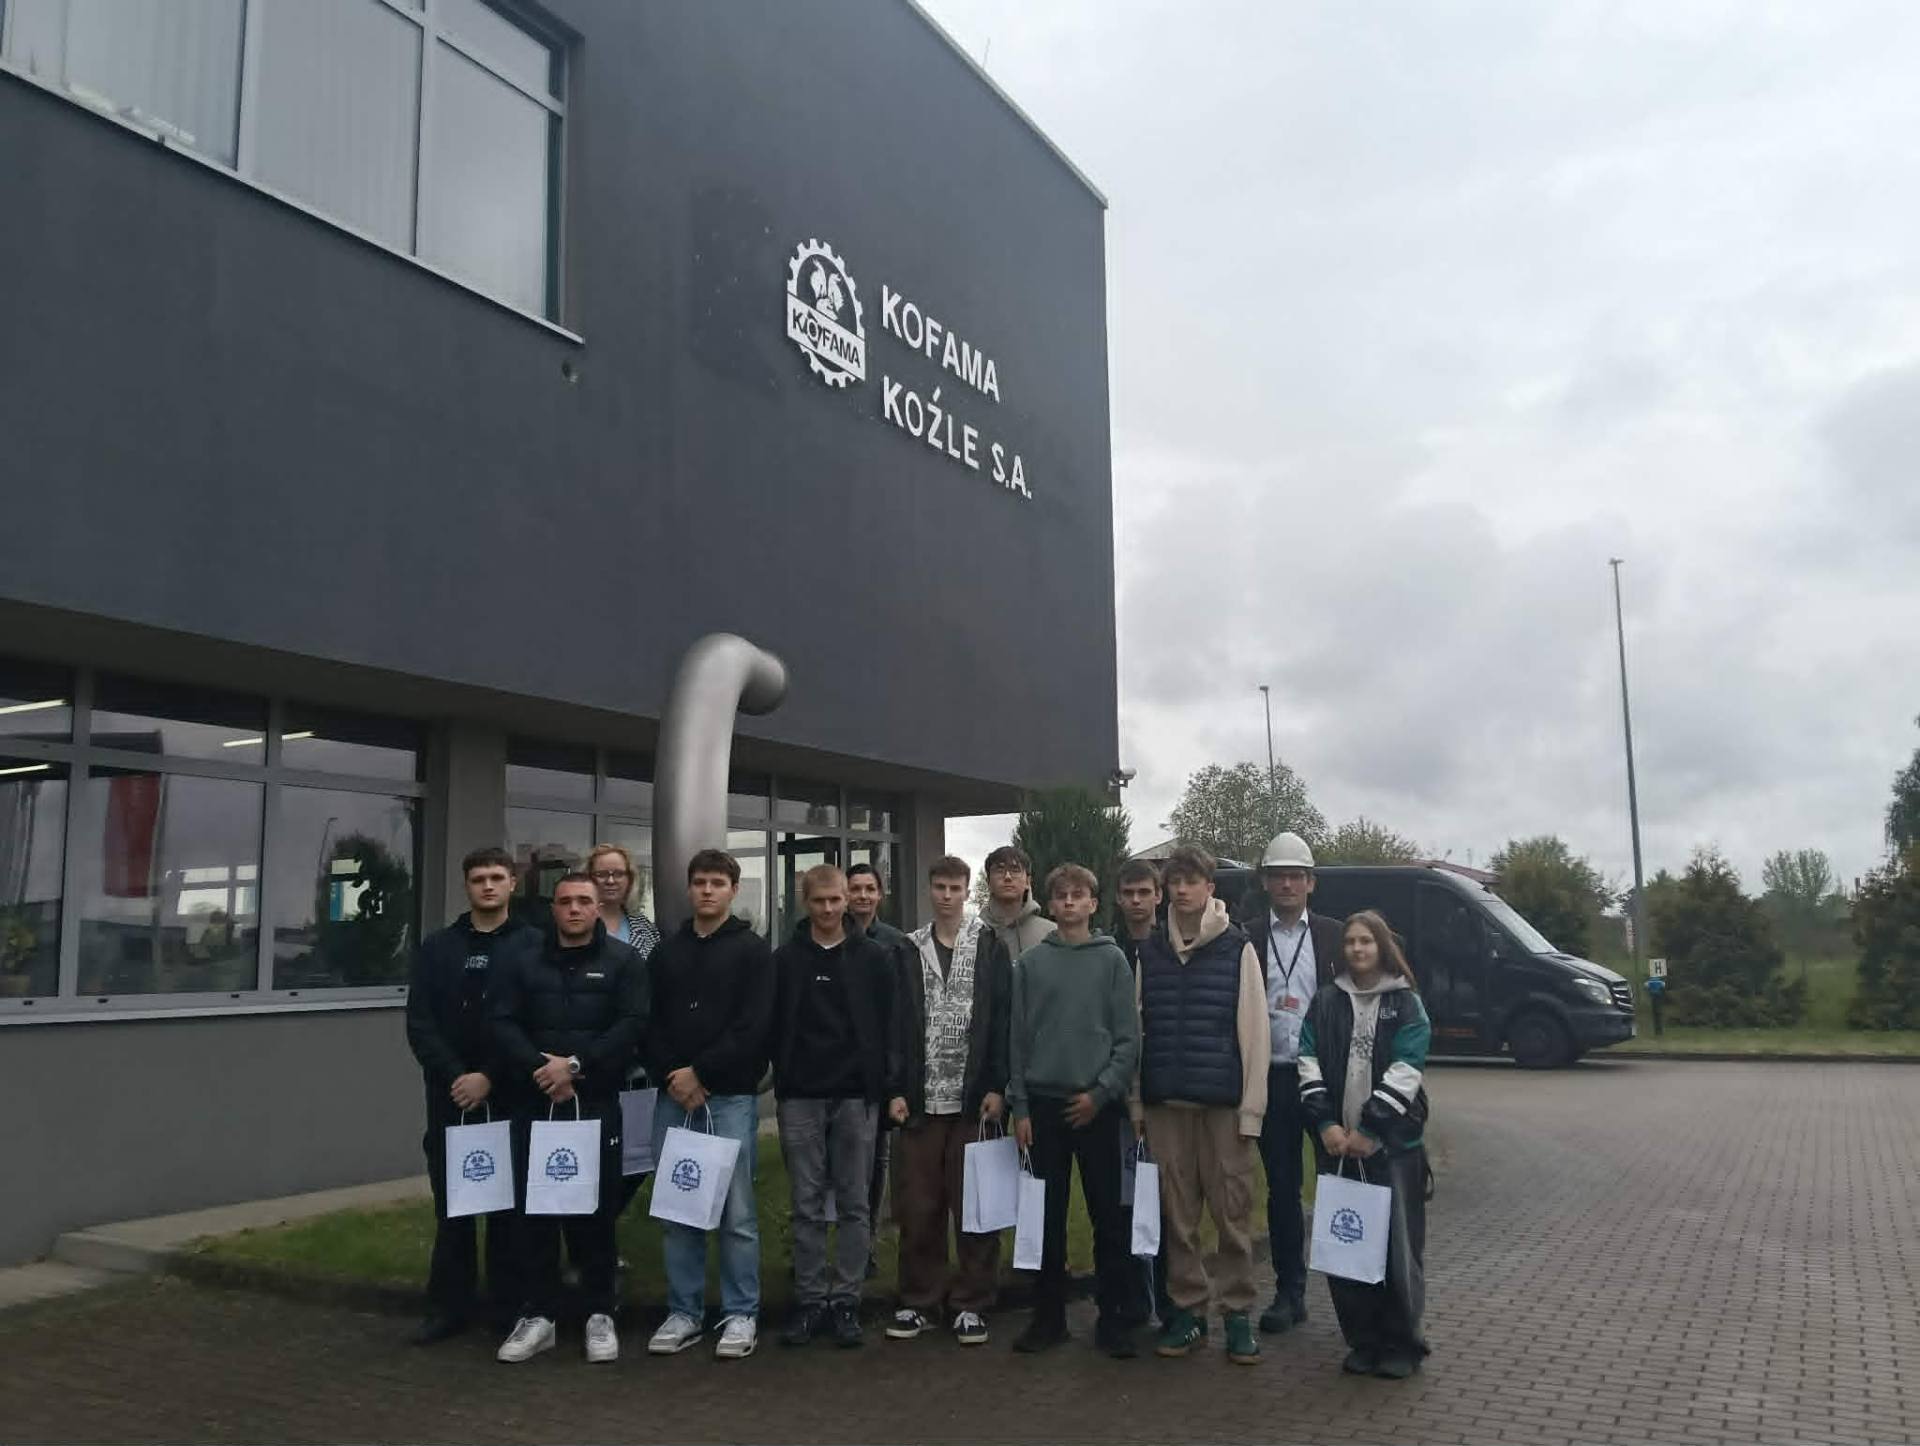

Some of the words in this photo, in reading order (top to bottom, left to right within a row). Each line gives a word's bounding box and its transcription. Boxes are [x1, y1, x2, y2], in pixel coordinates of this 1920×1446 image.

[792, 307, 861, 369] KOFAMA
[882, 284, 1000, 403] KOFAMA
[883, 375, 980, 470] KOŹLE
[990, 441, 1032, 500] S.A.
